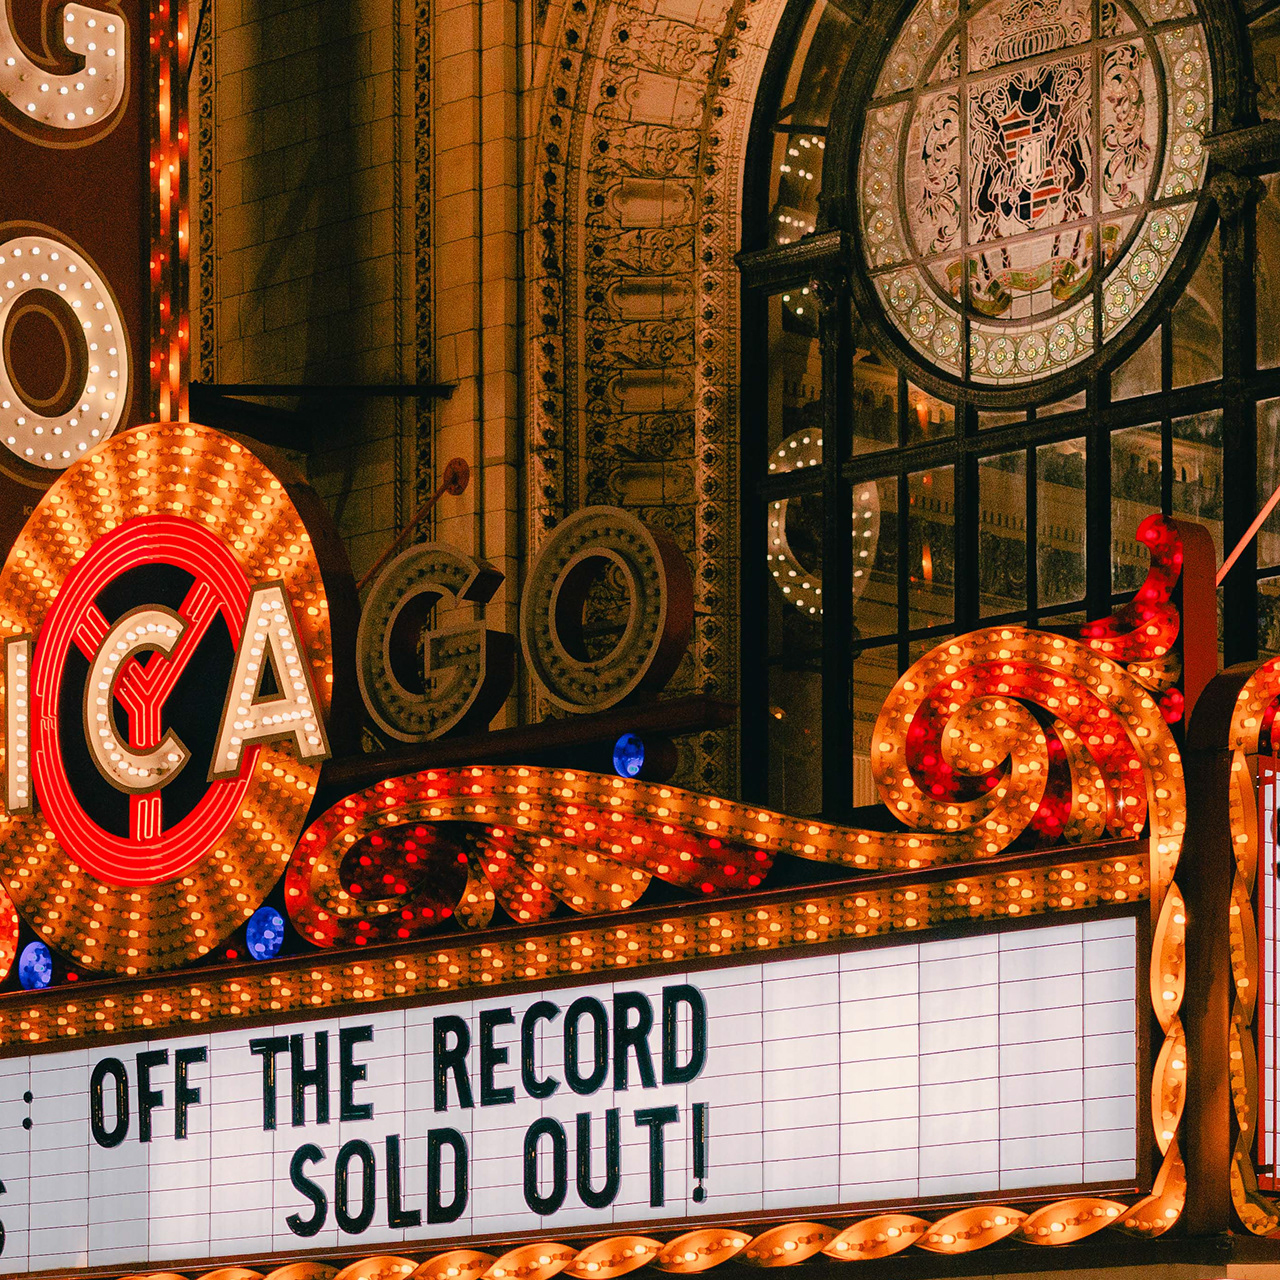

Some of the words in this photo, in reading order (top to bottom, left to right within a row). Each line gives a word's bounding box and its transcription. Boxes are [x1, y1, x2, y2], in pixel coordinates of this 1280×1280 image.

[90, 1045, 208, 1149] OFF
[249, 1024, 375, 1131] THE
[432, 983, 708, 1112] RECORD
[285, 1126, 471, 1238] SOLD
[523, 1101, 710, 1216] OUT!
